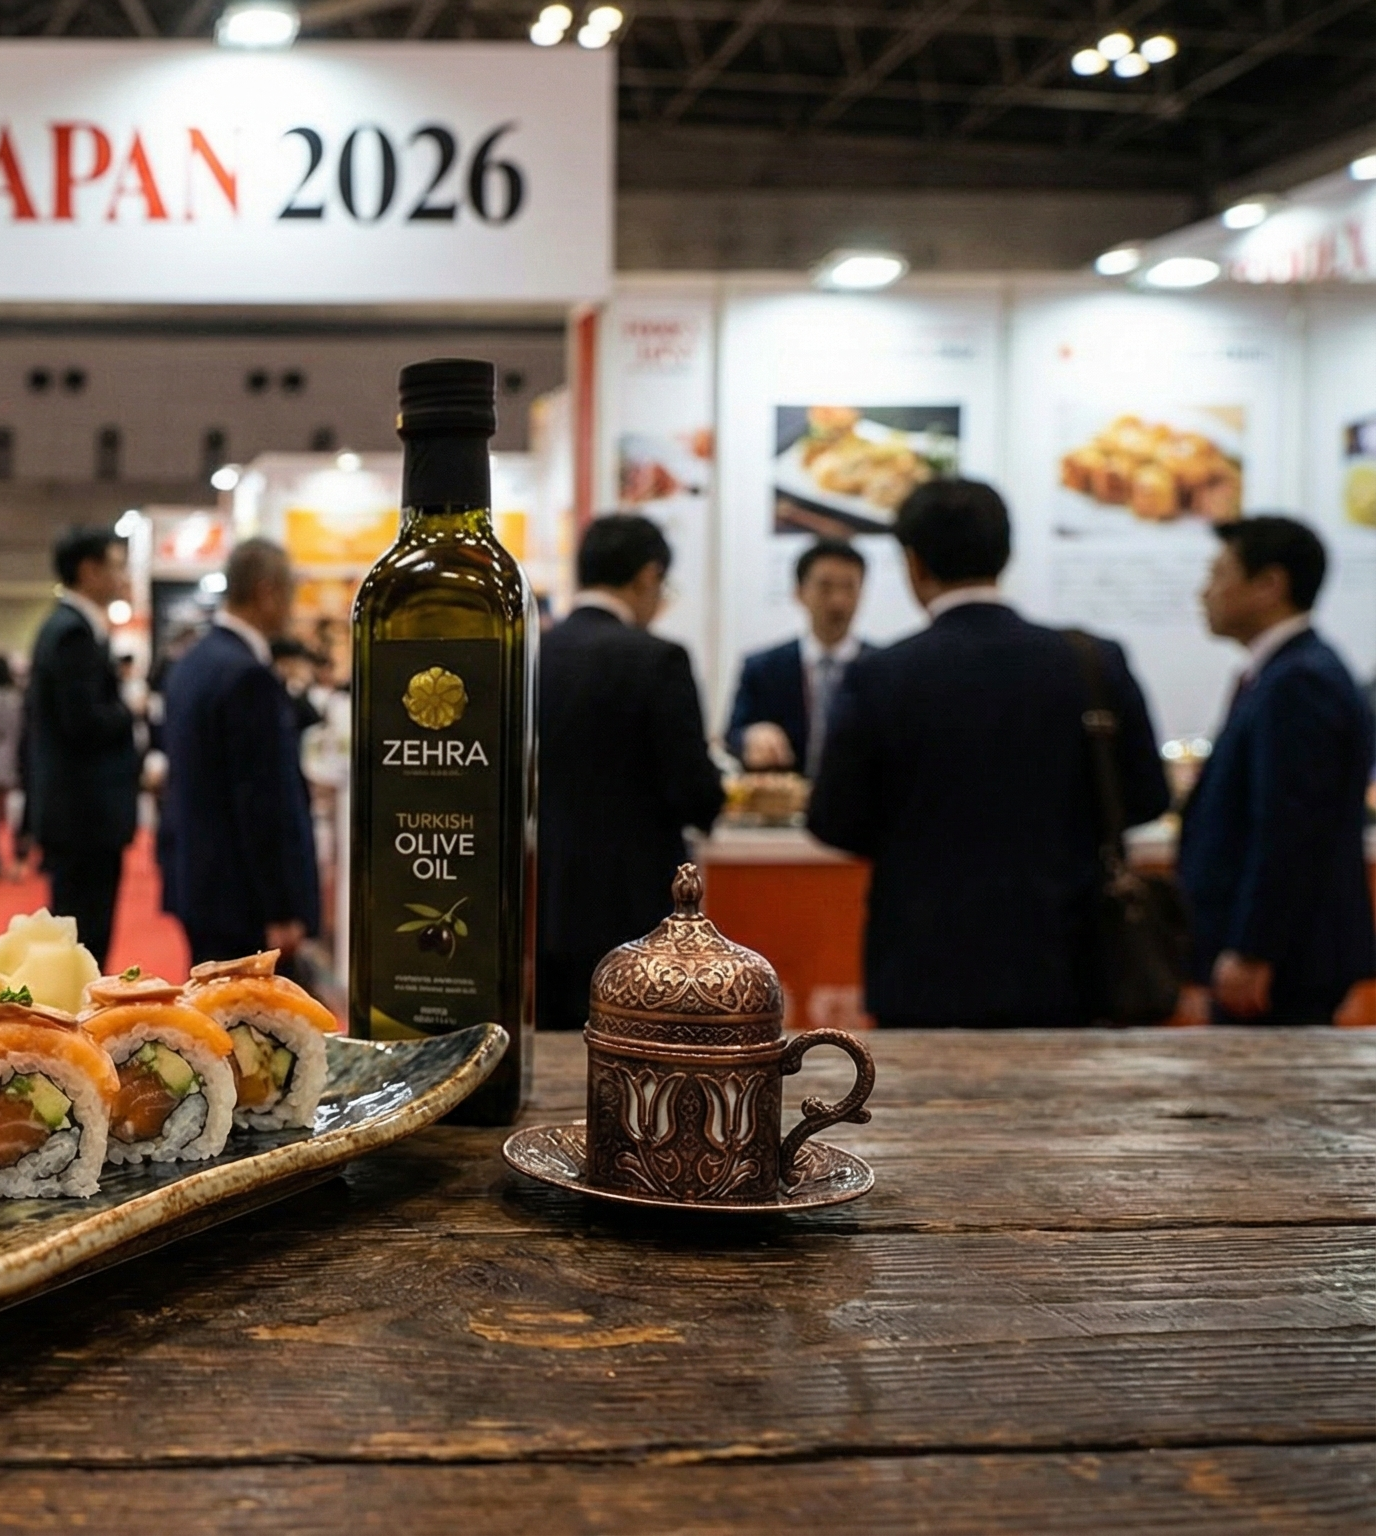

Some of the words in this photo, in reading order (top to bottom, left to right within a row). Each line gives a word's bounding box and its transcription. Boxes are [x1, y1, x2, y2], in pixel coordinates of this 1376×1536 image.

[279, 121, 527, 225] 2026
[382, 740, 490, 766] ZEHRA
[395, 813, 474, 829] TURKISH
[395, 832, 475, 855] OLIVE
[412, 857, 457, 880] OIL
